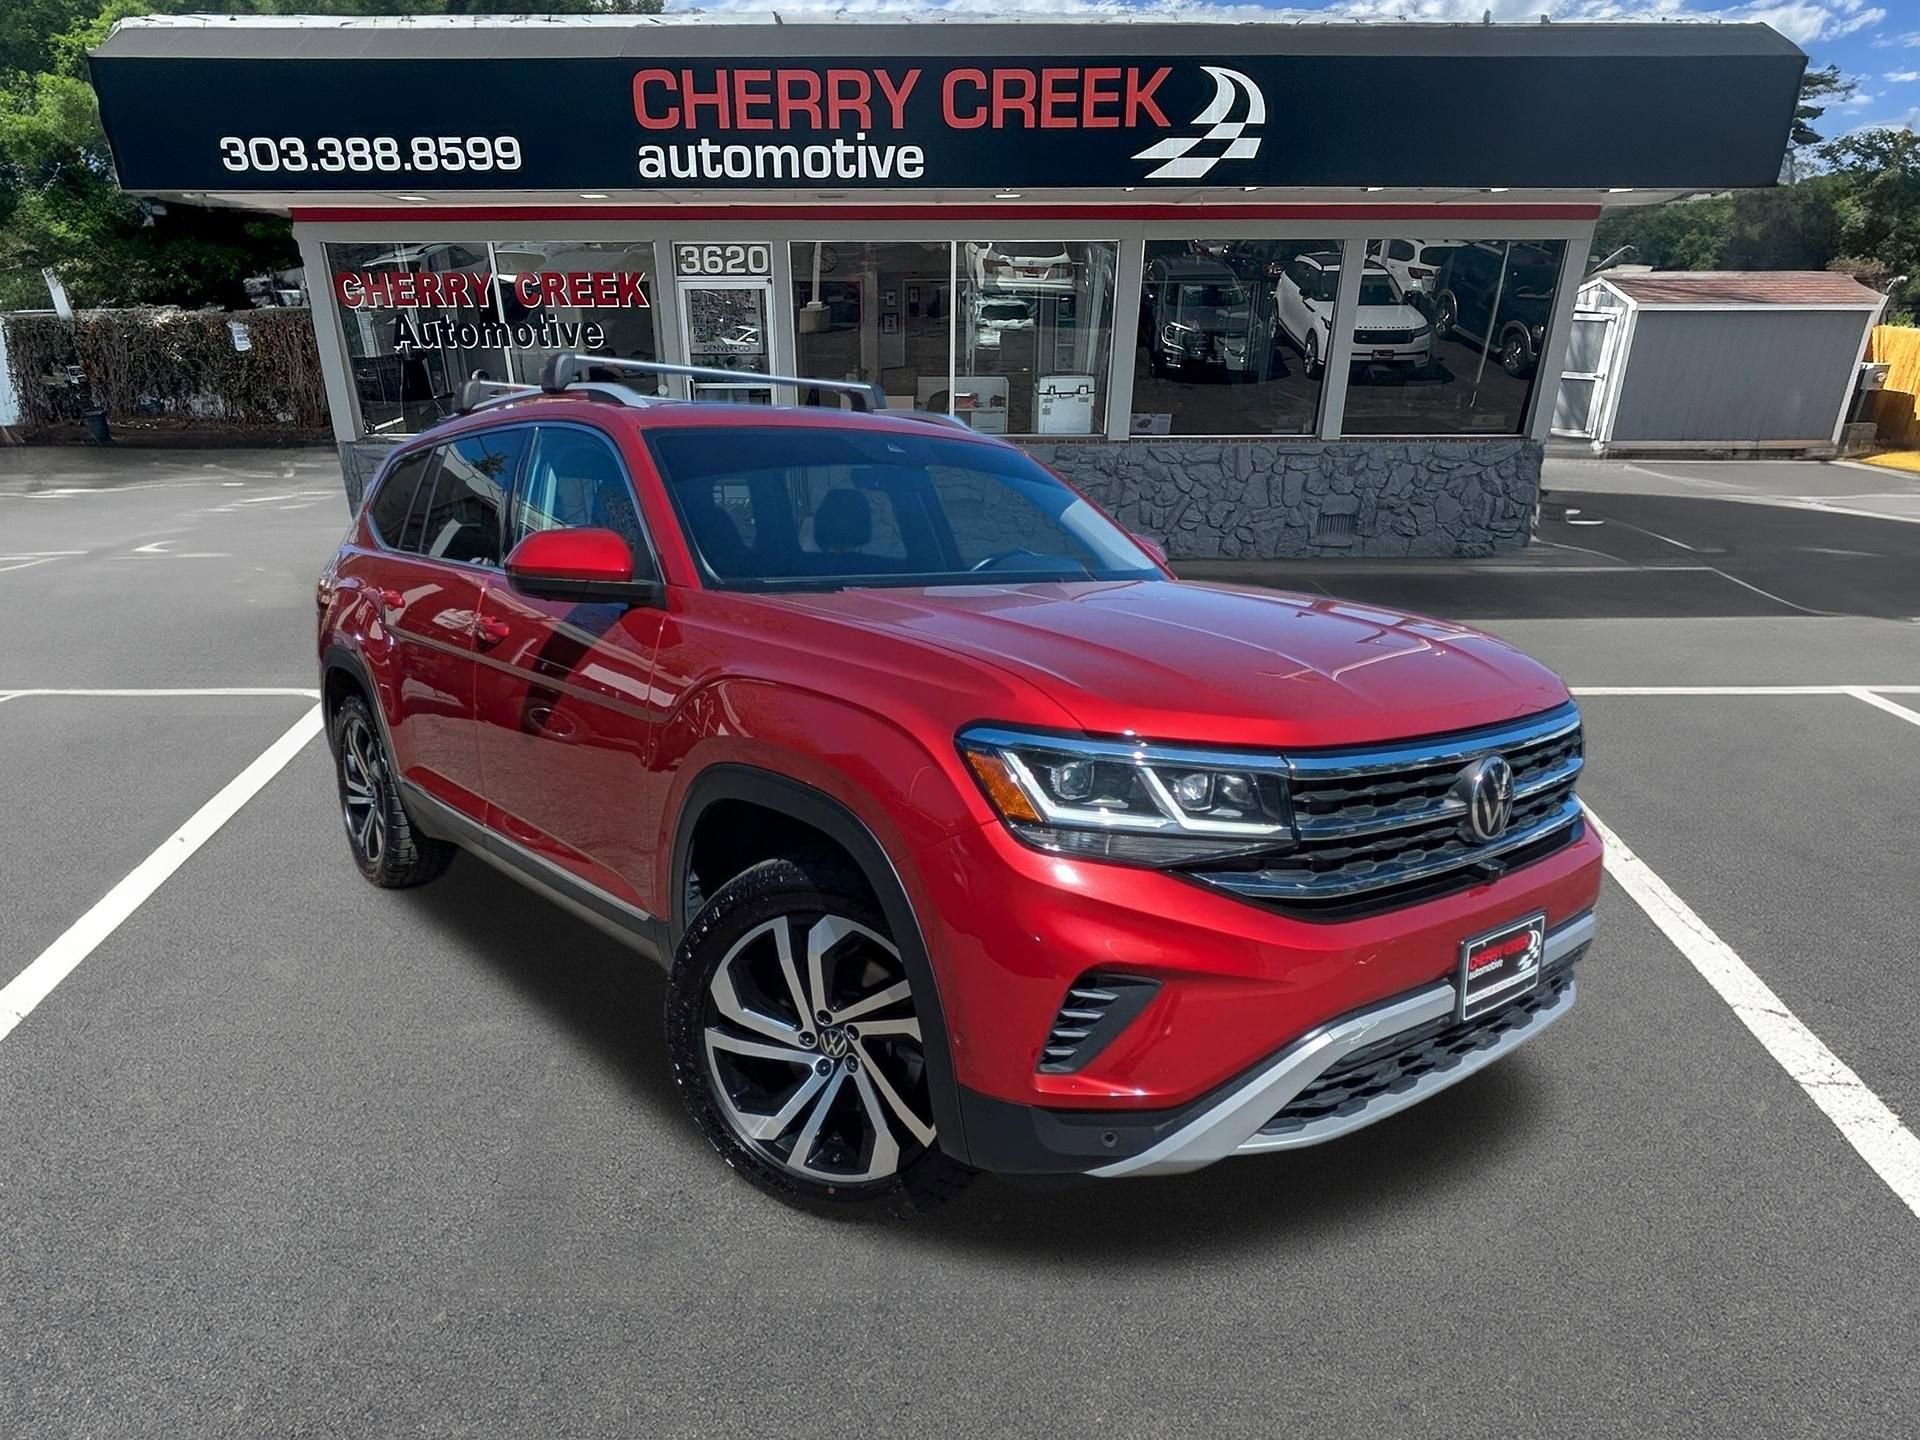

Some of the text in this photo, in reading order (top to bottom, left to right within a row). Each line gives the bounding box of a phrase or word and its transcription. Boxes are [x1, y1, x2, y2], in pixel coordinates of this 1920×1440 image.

[632, 67, 1173, 130] CHERRY CREEK
[219, 136, 522, 172] 303.388.8599
[638, 132, 925, 179] automotive
[680, 245, 769, 274] 3620
[334, 271, 650, 309] CHERRY CREEK
[393, 313, 606, 350] Automotive
